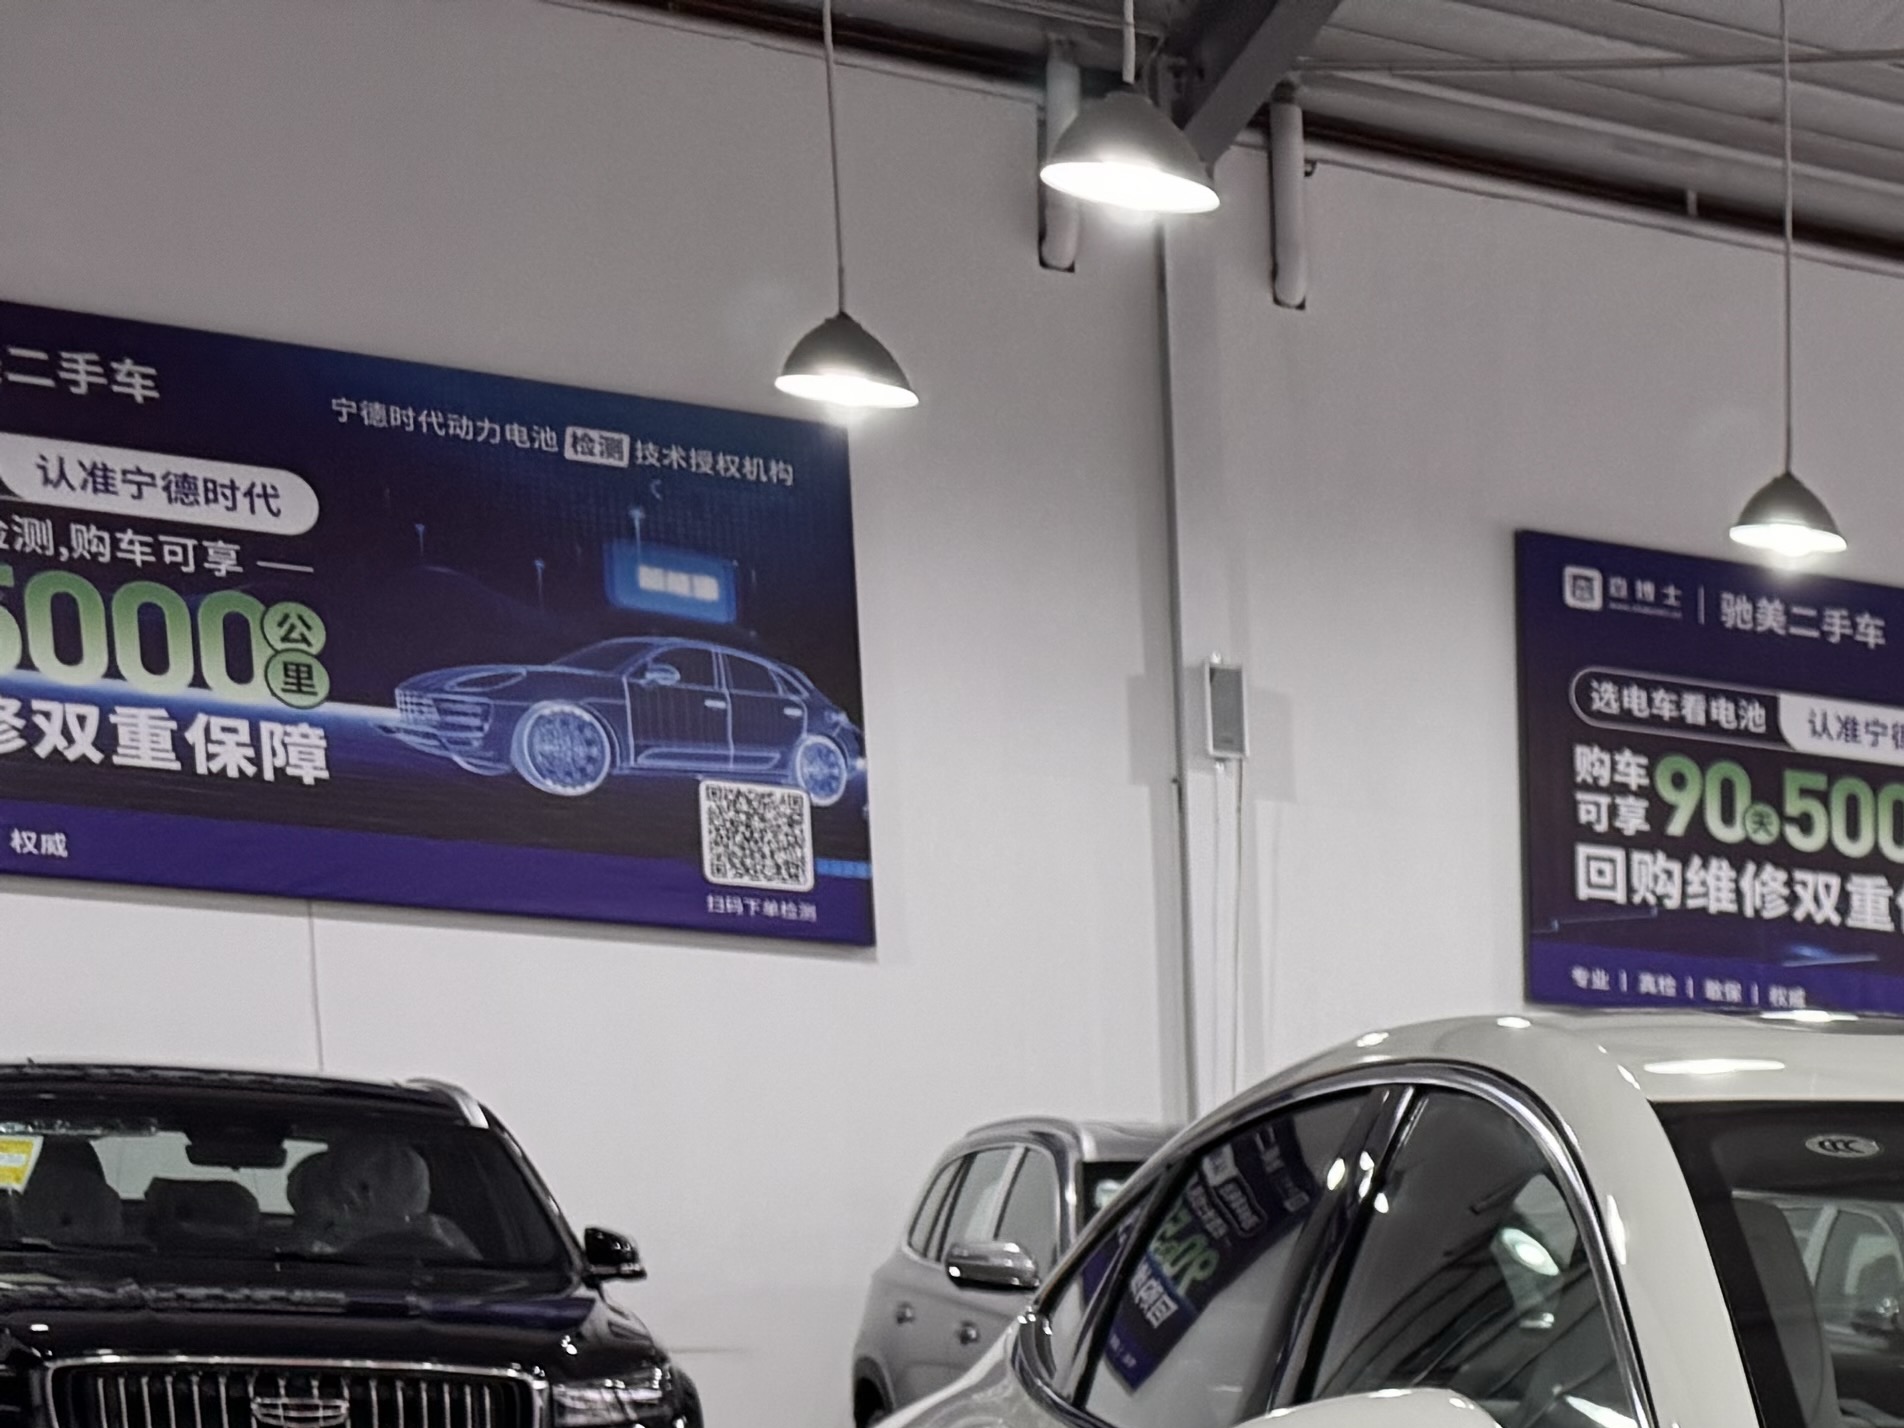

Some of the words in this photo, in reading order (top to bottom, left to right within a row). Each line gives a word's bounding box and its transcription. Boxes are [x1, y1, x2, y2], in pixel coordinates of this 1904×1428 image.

[332, 397, 559, 453] 宁德时代动力电池
[635, 440, 795, 487] 技术授权机构
[35, 454, 281, 517] 认准宁德时代
[0, 514, 244, 577] 测,购车可享
[1719, 591, 1886, 649] 驰美二手车
[1590, 679, 1767, 734] 选电车看电池
[1573, 743, 1650, 791] 购车
[1575, 792, 1651, 836] 可享
